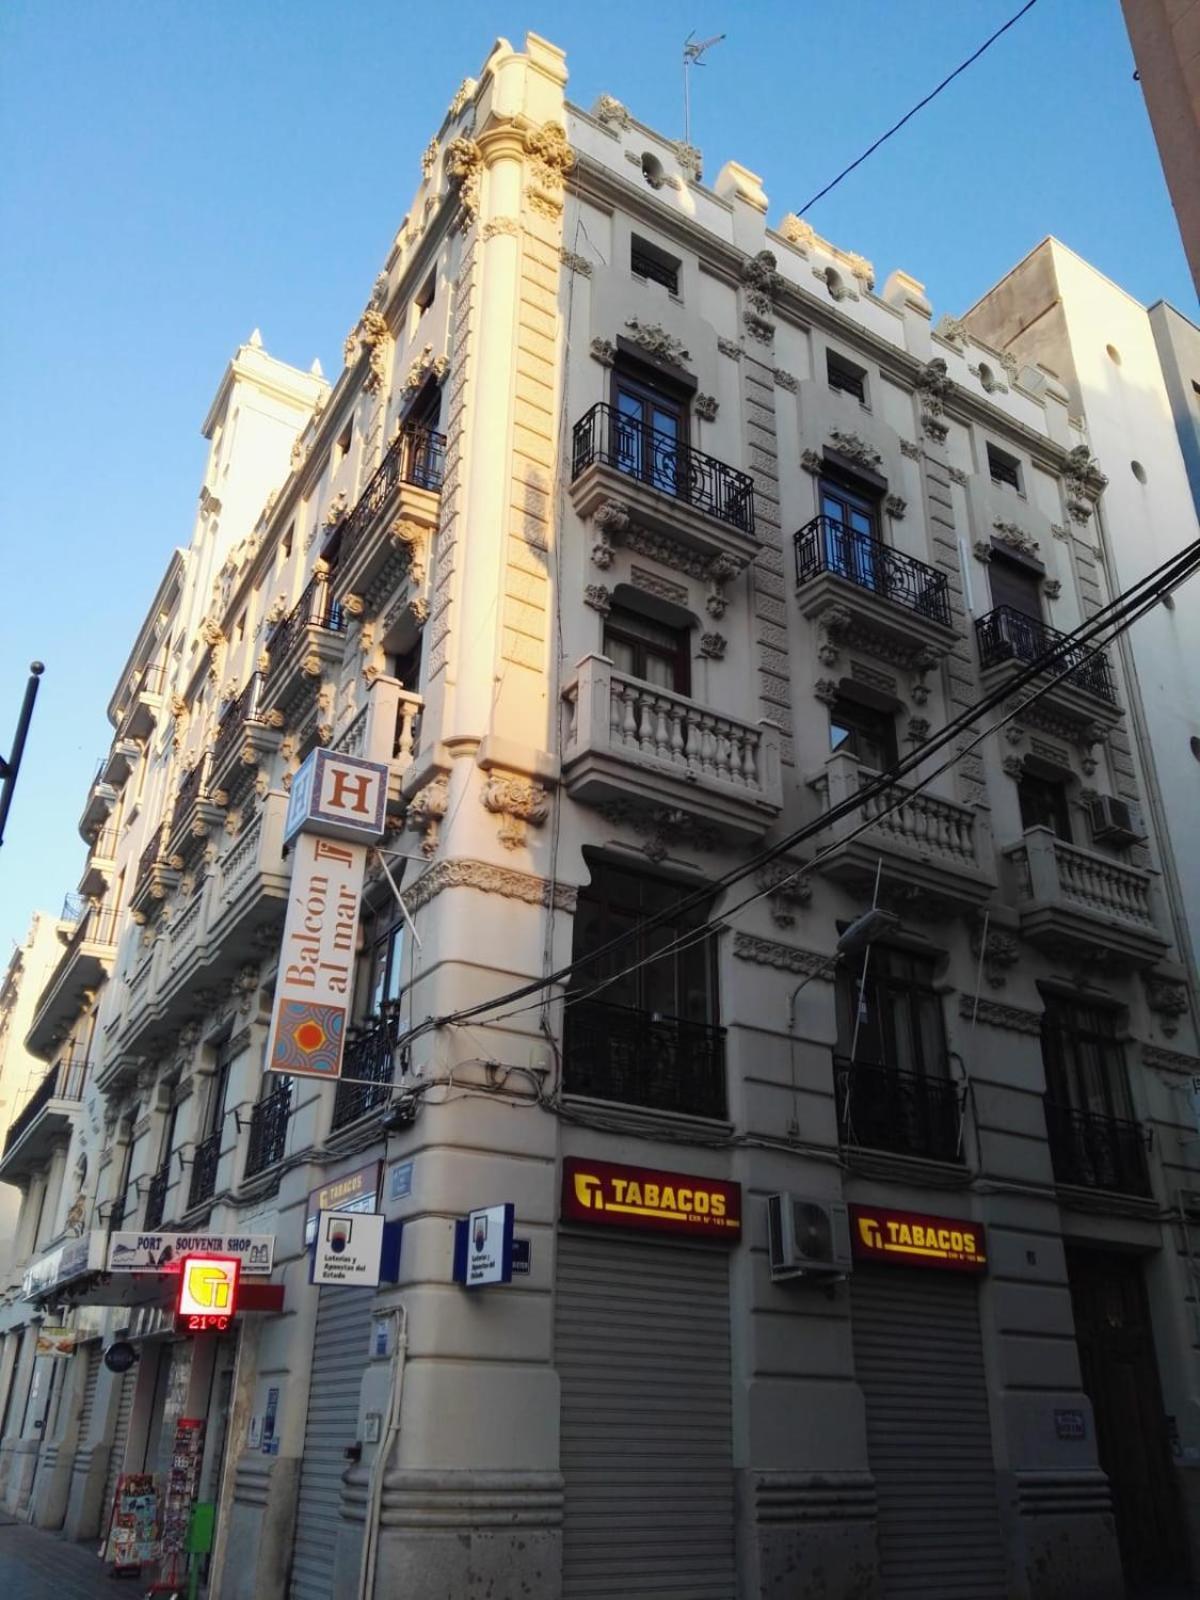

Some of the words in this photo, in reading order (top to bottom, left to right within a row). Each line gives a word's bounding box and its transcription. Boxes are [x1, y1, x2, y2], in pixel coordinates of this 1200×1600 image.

[327, 768, 373, 814] H
[286, 876, 328, 988] Balcón
[333, 884, 358, 951] mar
[319, 961, 348, 993] al
[611, 1178, 726, 1216] TABACOS
[137, 1237, 162, 1250] PORT
[175, 1237, 223, 1250] SOUVENIR
[228, 1238, 252, 1251] SHOP
[887, 1221, 976, 1253] TABACOS
